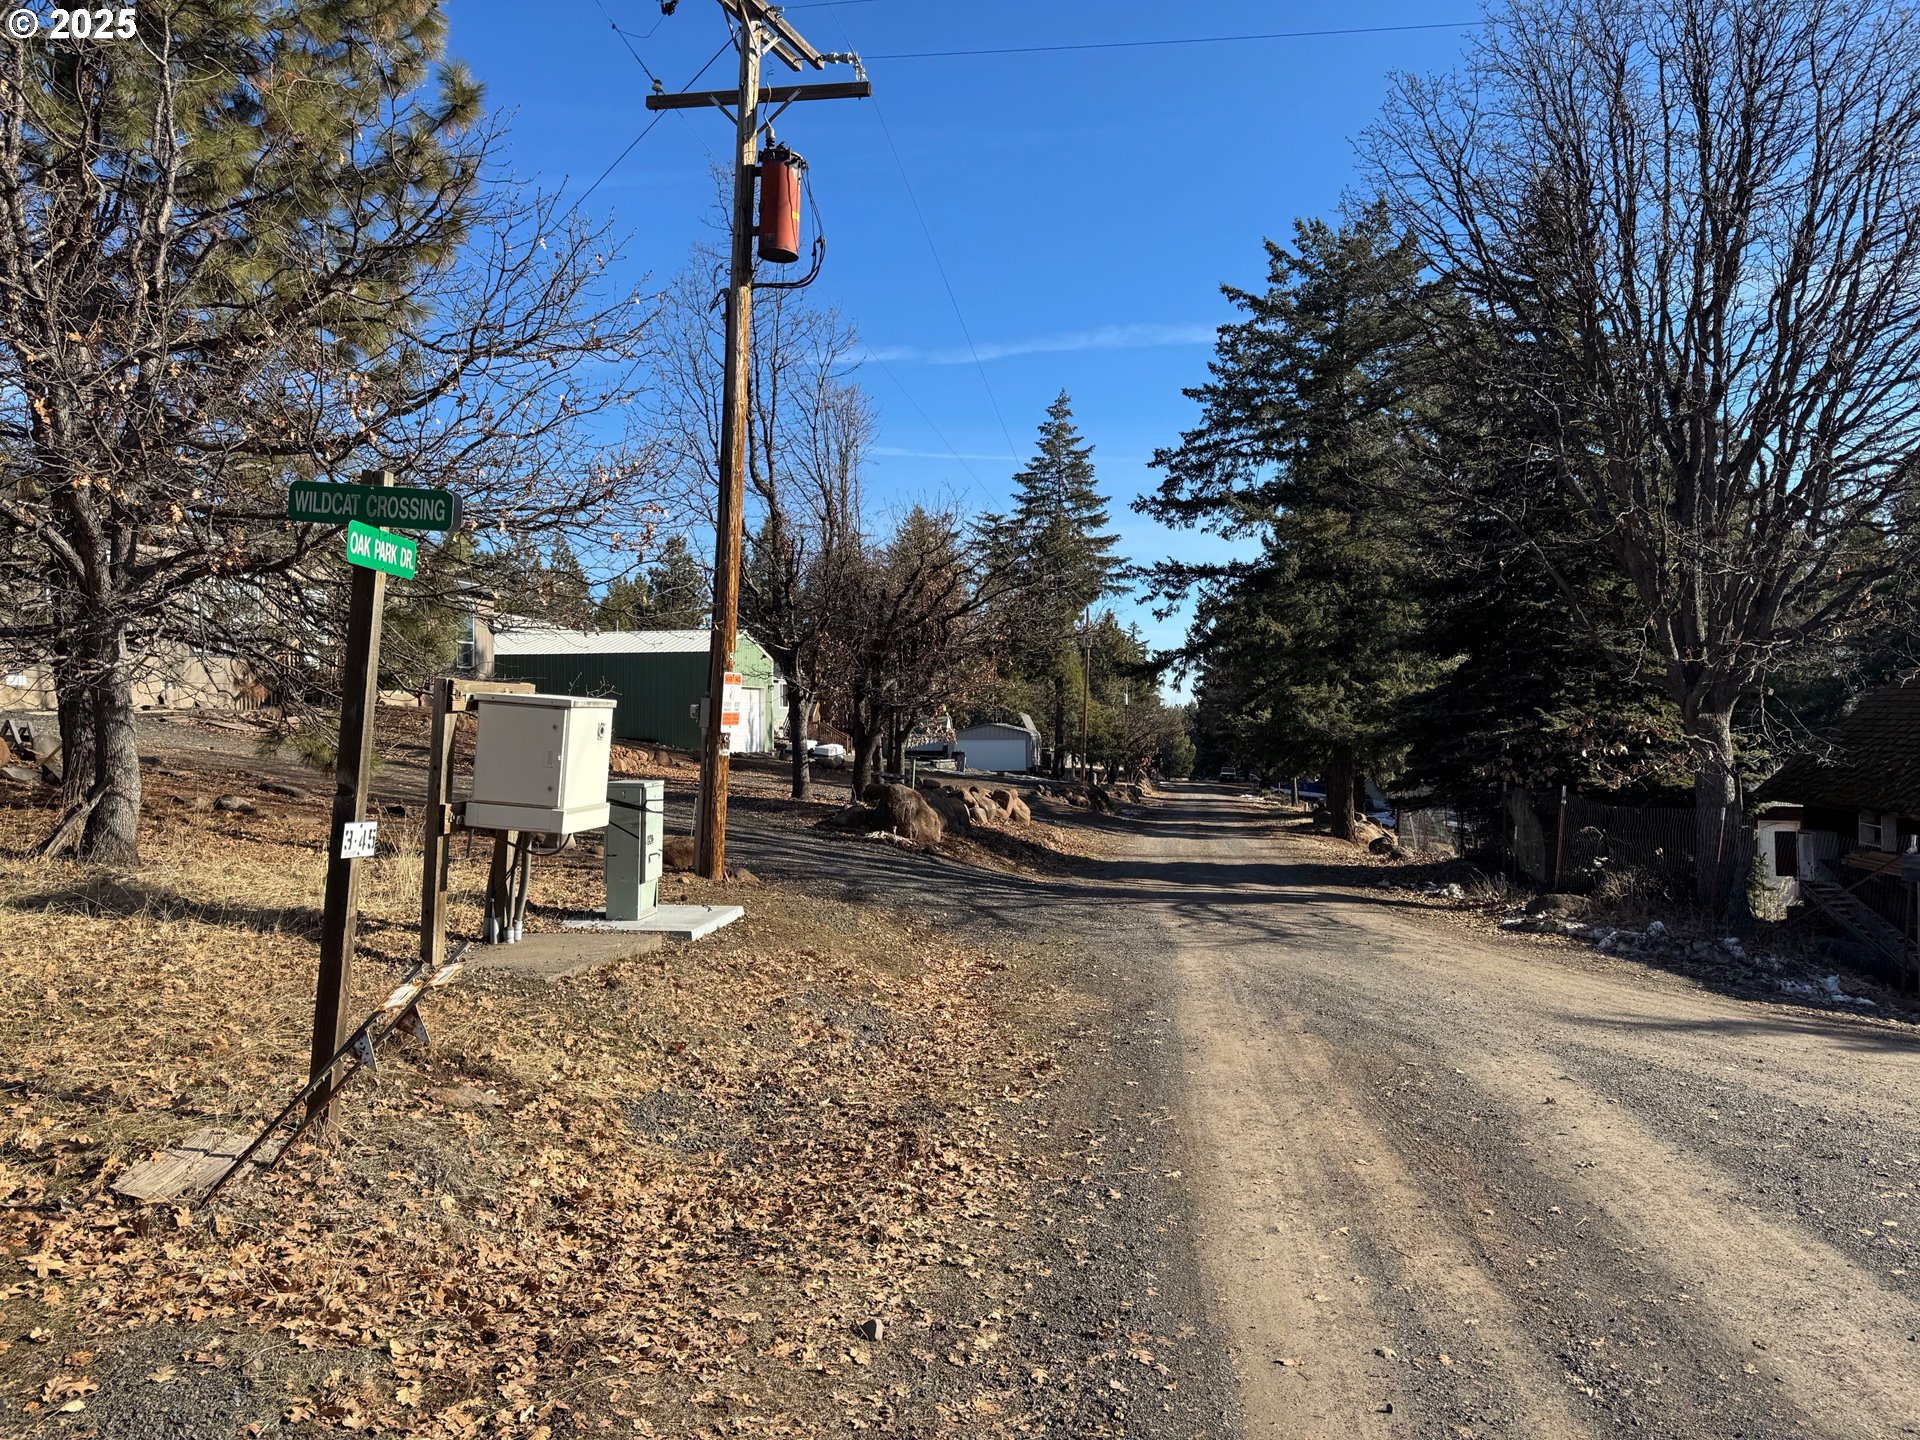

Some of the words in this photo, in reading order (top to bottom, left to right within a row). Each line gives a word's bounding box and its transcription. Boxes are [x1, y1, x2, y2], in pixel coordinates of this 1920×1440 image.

[295, 490, 361, 516] WILDCAT
[366, 494, 446, 522] CROSSING
[349, 531, 371, 558] OAK
[374, 540, 398, 566] PARK
[400, 547, 414, 570] DR.
